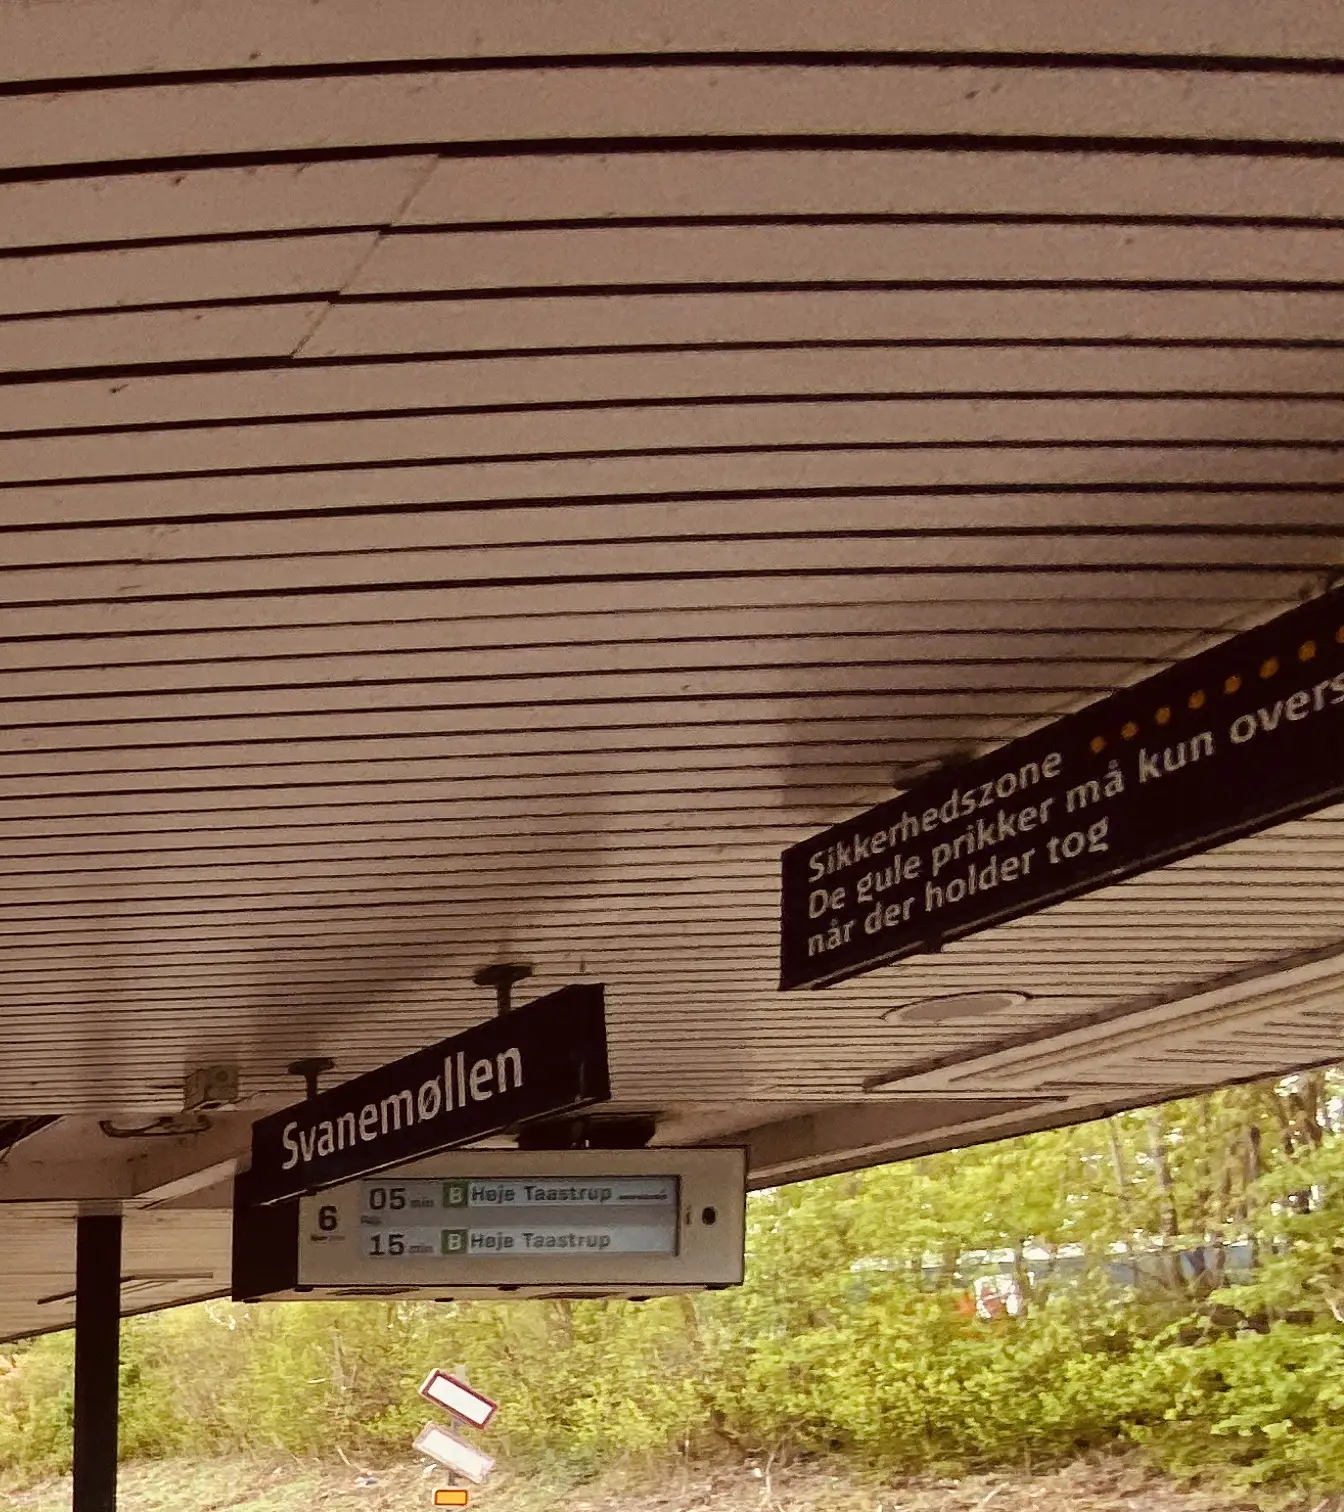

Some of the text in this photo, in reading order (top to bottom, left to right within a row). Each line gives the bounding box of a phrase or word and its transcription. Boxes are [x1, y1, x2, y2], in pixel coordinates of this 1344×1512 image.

[807, 886, 847, 919] De
[856, 848, 921, 903] gule
[931, 796, 1055, 876] prikker
[1065, 759, 1126, 814] må
[1137, 730, 1216, 784] kun
[808, 751, 1063, 884] Sikkerhedszone
[806, 815, 1111, 957] når der holder tog
[281, 1047, 524, 1171] Svanemøllen
[318, 1205, 338, 1232] 6
[368, 1187, 407, 1210] 05
[449, 1186, 463, 1205] B
[523, 1184, 613, 1204] Taastrup
[369, 1233, 406, 1256] 15
[447, 1233, 462, 1251] B
[521, 1232, 612, 1251] Taastrup
